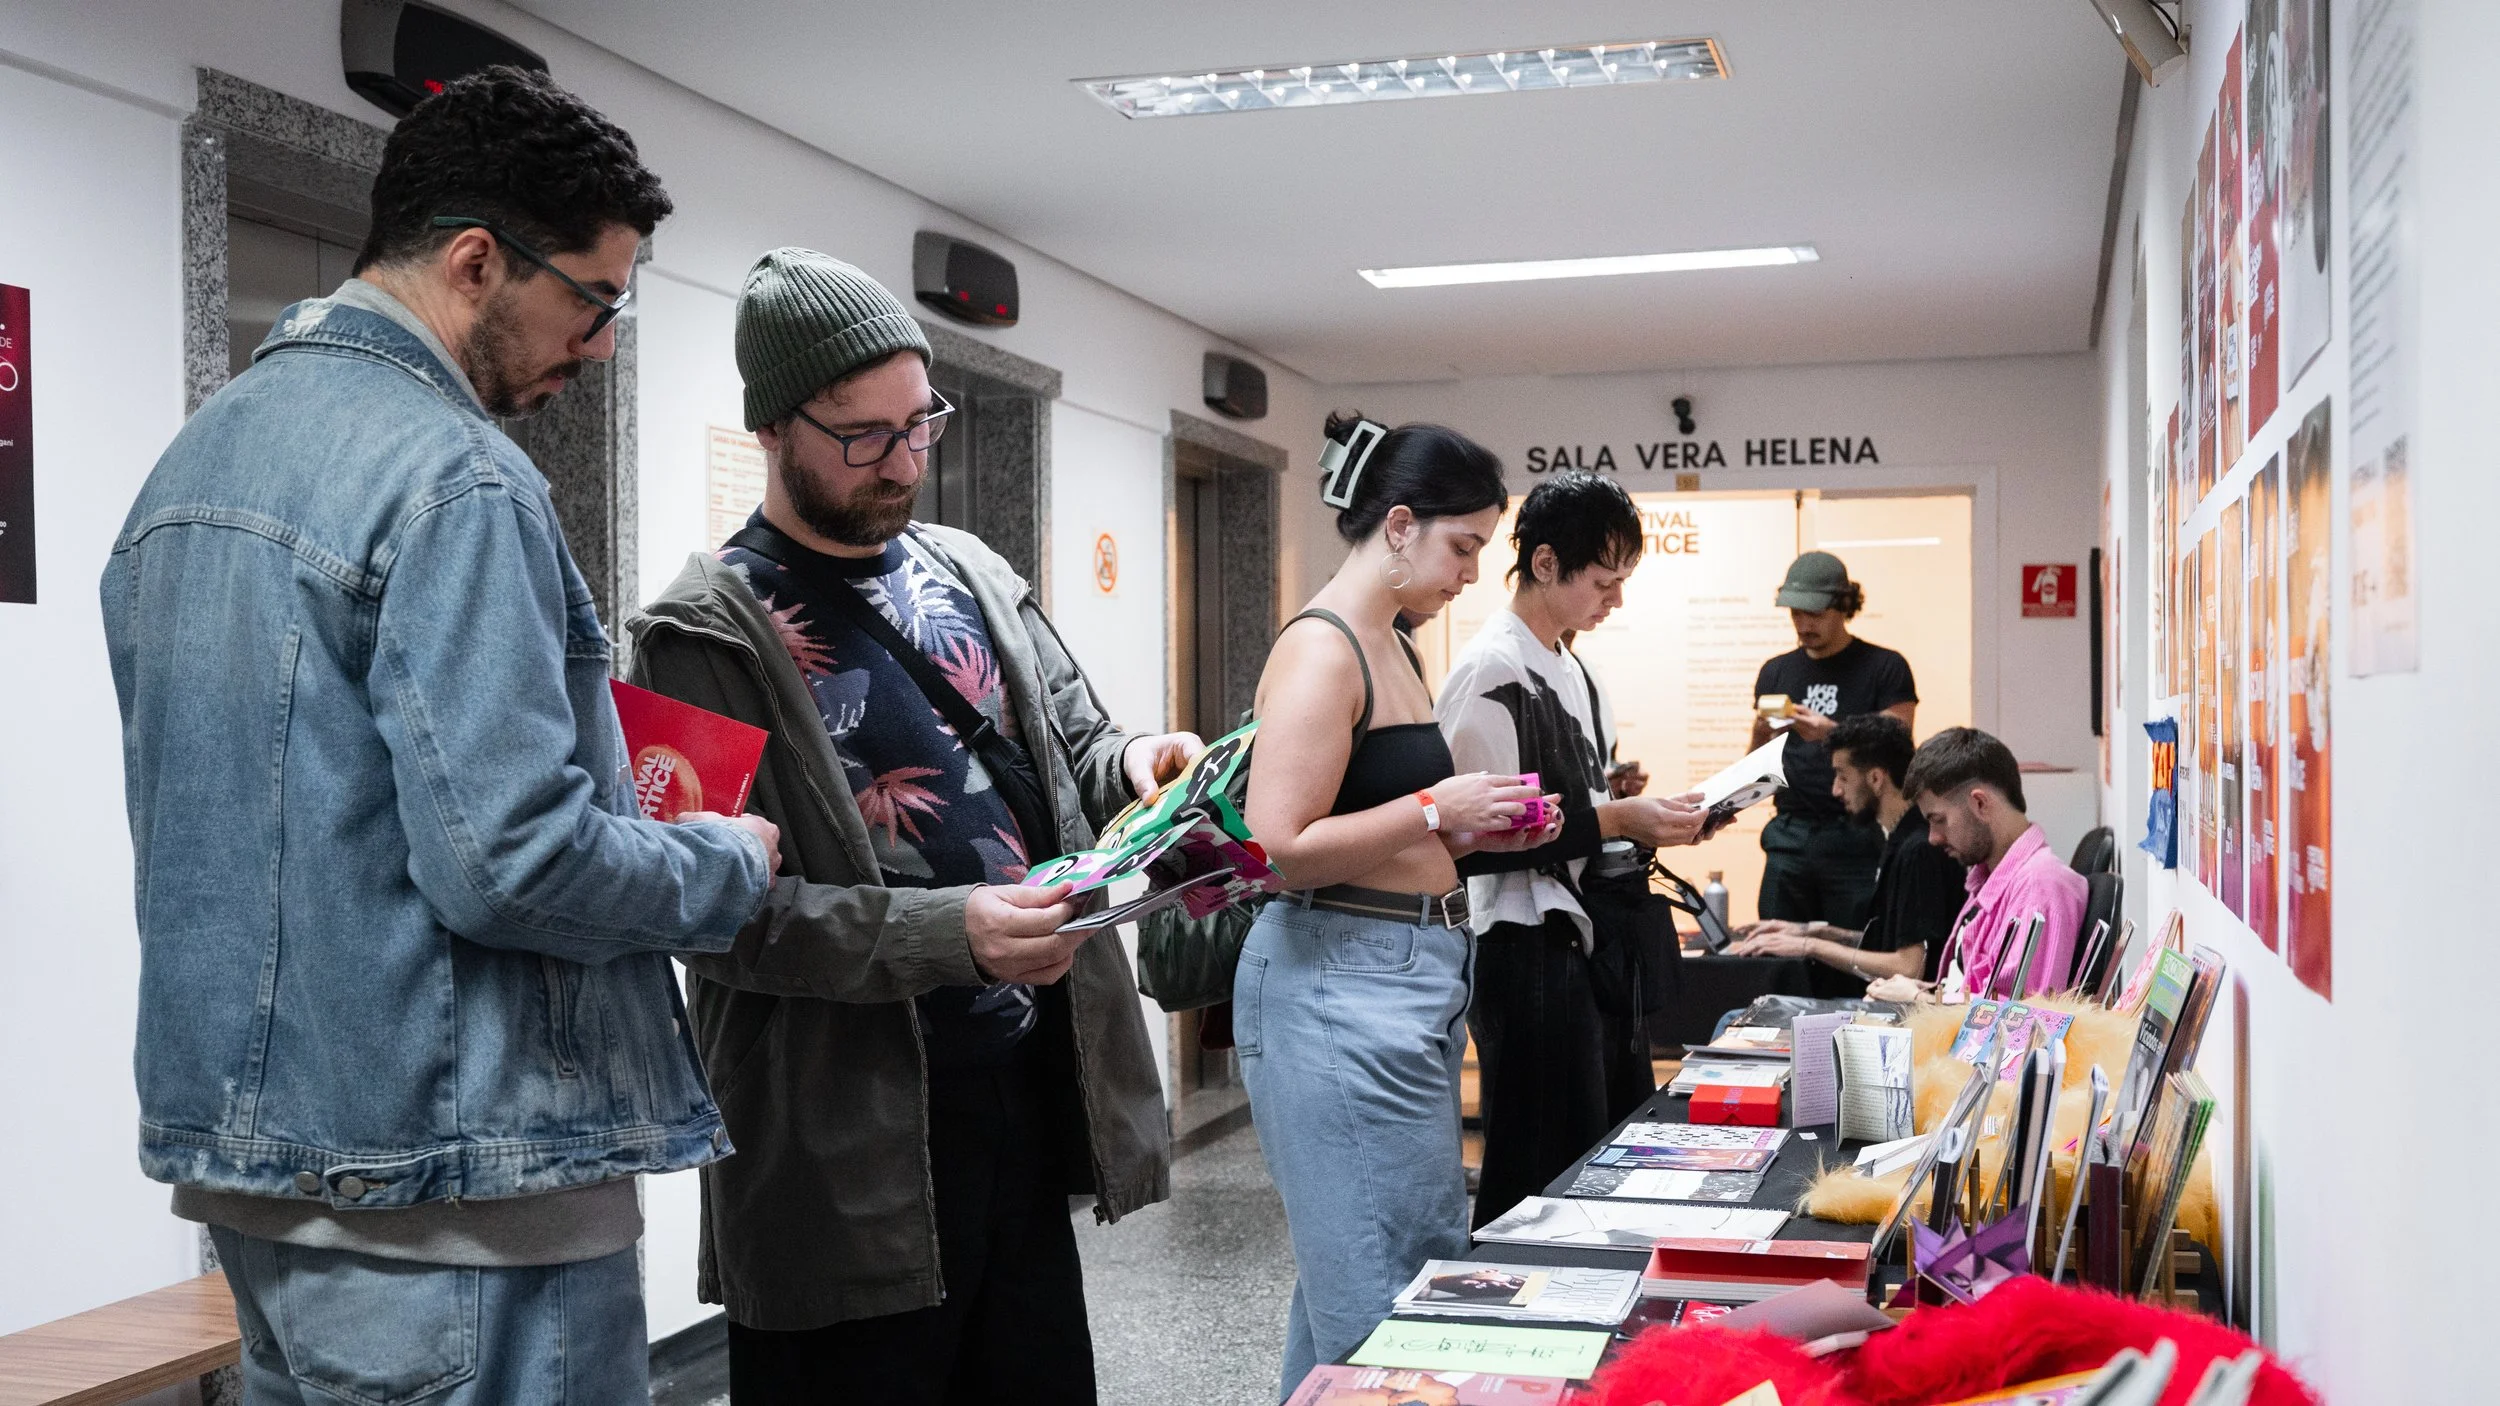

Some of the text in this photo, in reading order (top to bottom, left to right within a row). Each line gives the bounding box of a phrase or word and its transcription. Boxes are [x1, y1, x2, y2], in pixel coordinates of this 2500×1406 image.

[1526, 437, 1880, 474] SALA VERA HELENA
[1640, 510, 1699, 530] IVAL
